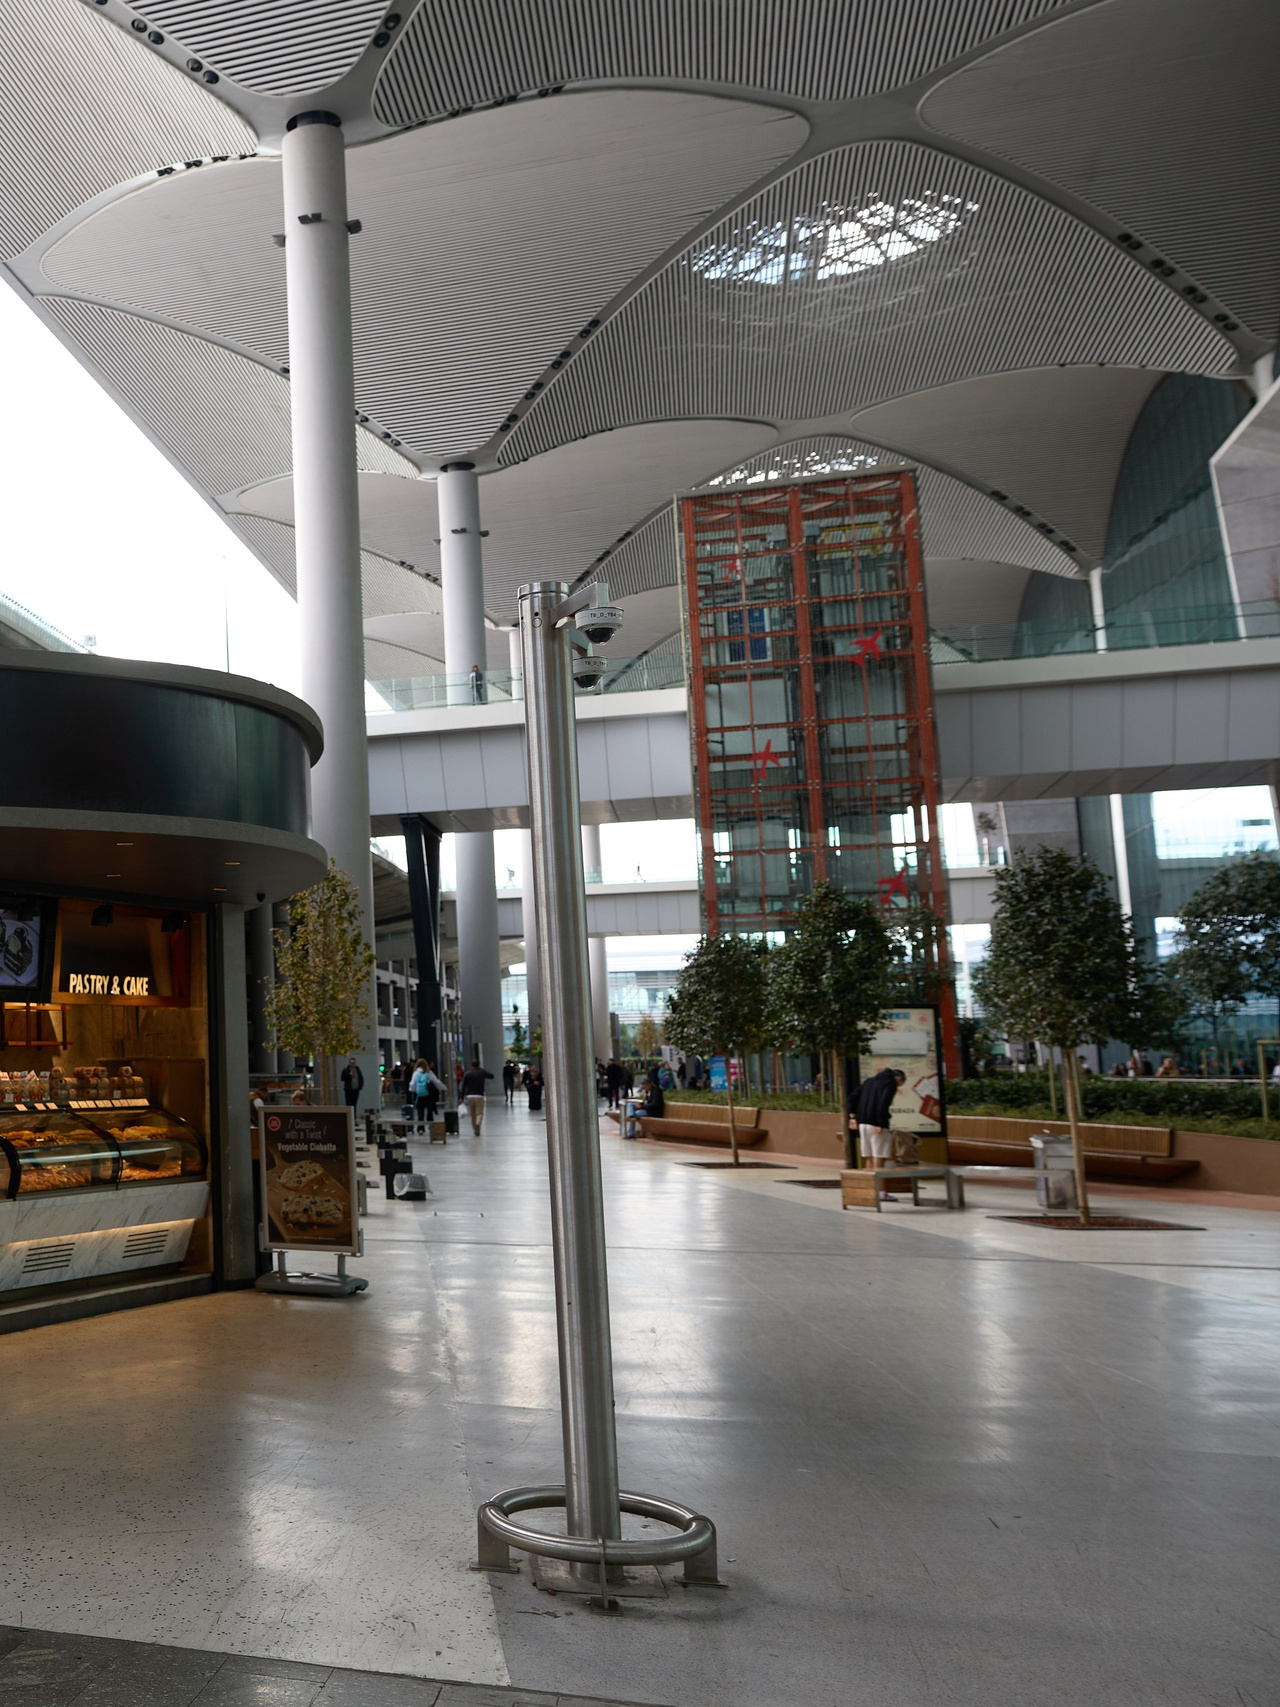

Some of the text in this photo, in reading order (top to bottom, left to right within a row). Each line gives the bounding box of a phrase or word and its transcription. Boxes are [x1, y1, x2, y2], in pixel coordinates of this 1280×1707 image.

[69, 973, 149, 996] PASTRY & CAKE
[294, 1119, 317, 1129] Classic
[285, 1130, 298, 1139] with
[306, 1129, 322, 1139] Twist
[277, 1142, 337, 1153] Vegetable Ciabatta
